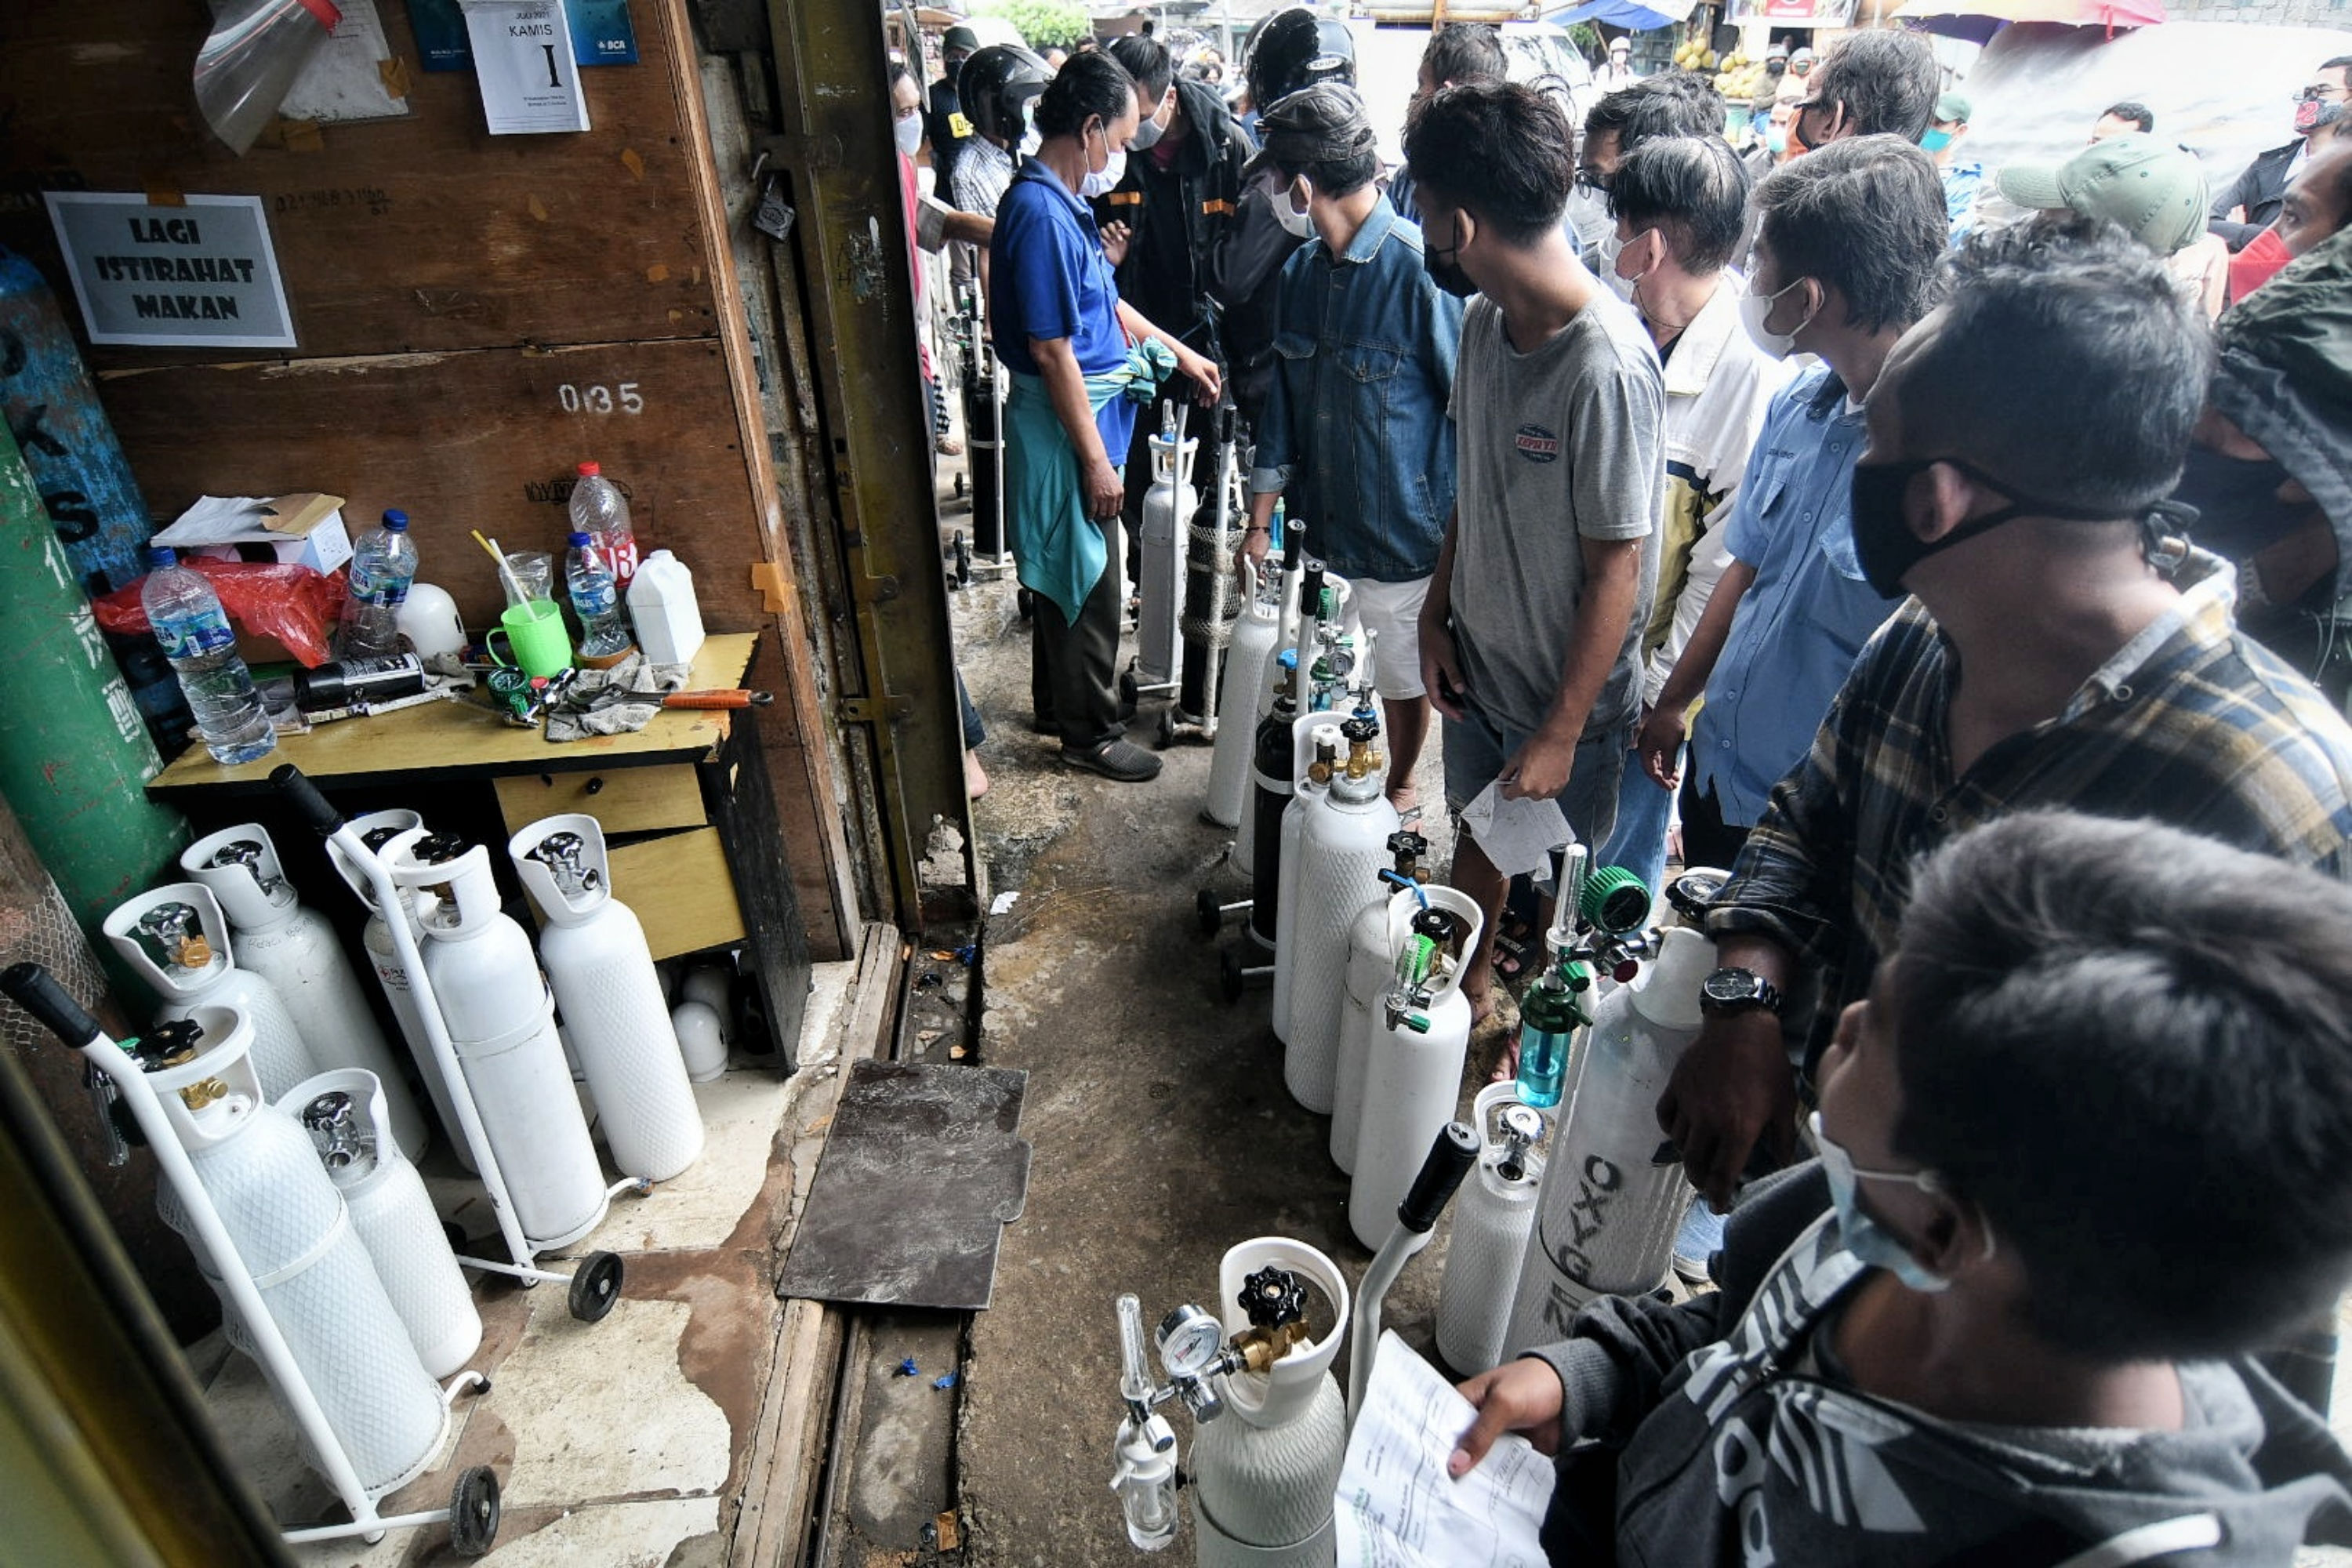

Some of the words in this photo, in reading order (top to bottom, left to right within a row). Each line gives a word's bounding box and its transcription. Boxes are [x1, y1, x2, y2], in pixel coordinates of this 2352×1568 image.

[509, 24, 553, 37] KAMIS
[128, 218, 201, 244] LAGI
[94, 256, 254, 283] ISTIRAHAT
[132, 295, 239, 320] MAKAN
